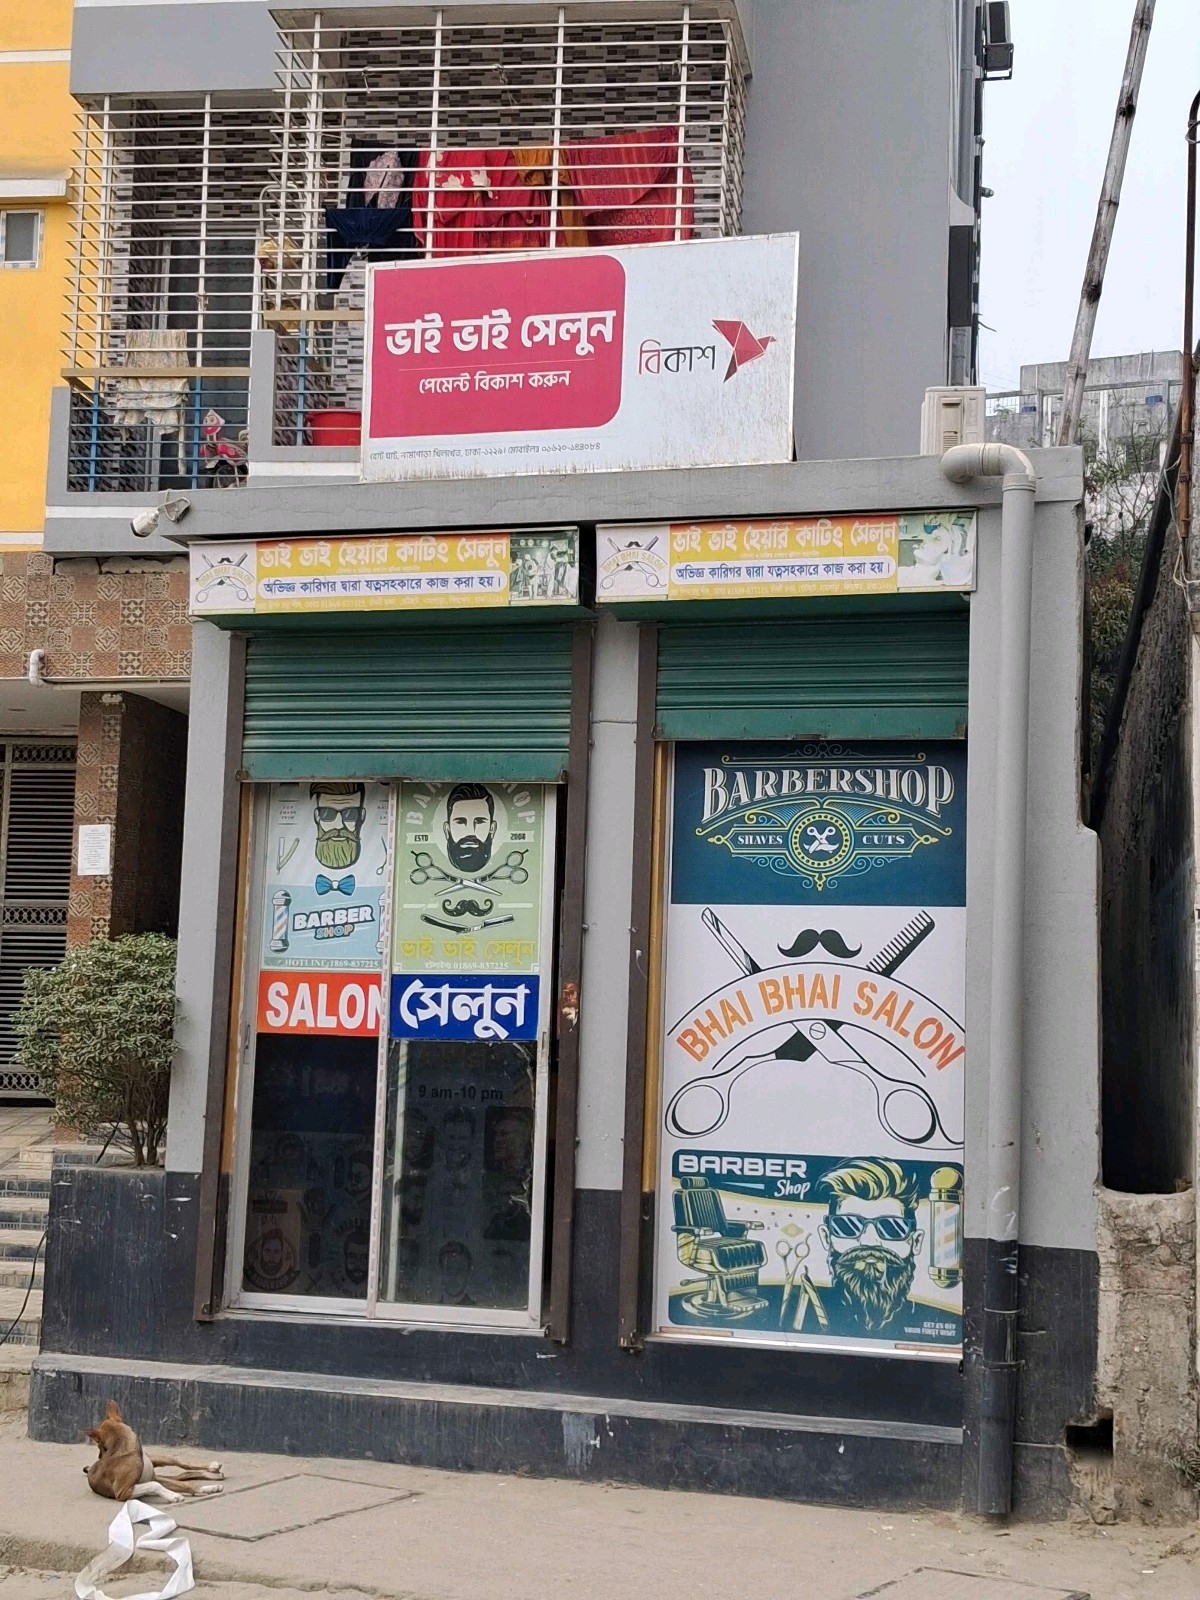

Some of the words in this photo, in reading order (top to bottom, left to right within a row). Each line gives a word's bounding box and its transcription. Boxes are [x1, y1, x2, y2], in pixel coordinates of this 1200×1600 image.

[384, 312, 444, 356] ভাই
[450, 308, 512, 352] ভাই
[521, 310, 617, 357] সেলুন
[639, 339, 716, 375] বিকাশ
[419, 372, 470, 394] পেমেন্ট
[475, 370, 523, 391] বিকাশ
[528, 370, 571, 389] করুন
[671, 525, 702, 553] ভাই
[707, 524, 738, 552] ভাই
[743, 525, 790, 551] হেয়ার
[795, 518, 844, 549] কাটিং
[850, 520, 897, 553] সেলুন
[258, 542, 292, 569] ভাই
[298, 540, 332, 568] ভাই
[338, 541, 389, 566] হেয়ার
[395, 535, 449, 563] কাটিং
[457, 537, 508, 568] সেলুন
[708, 563, 742, 579] কারিগর
[745, 565, 764, 578] দ্বারা
[822, 563, 844, 575] কাজ
[847, 562, 867, 574] করা
[300, 578, 338, 593] কারিগর
[340, 580, 361, 592] দ্বারা
[425, 577, 450, 589] কাজ
[453, 576, 474, 589] করা
[701, 765, 955, 825] BARBERSHOP
[737, 835, 784, 846] SHAVES
[862, 835, 905, 845] CUTS
[293, 905, 375, 931] BARBER
[314, 924, 354, 940] SHOP
[399, 935, 435, 960] ভাই
[442, 935, 477, 960] ভাই
[484, 940, 537, 965] সেলুন
[400, 978, 531, 1040] সেলুন
[676, 989, 754, 1062] BHAI
[758, 973, 841, 1016] BHAI
[853, 980, 966, 1071] SALON
[418, 1084, 426, 1098] 9
[481, 1088, 503, 1102] pm
[678, 1154, 808, 1179] BARBER
[774, 1179, 811, 1200] Shop
